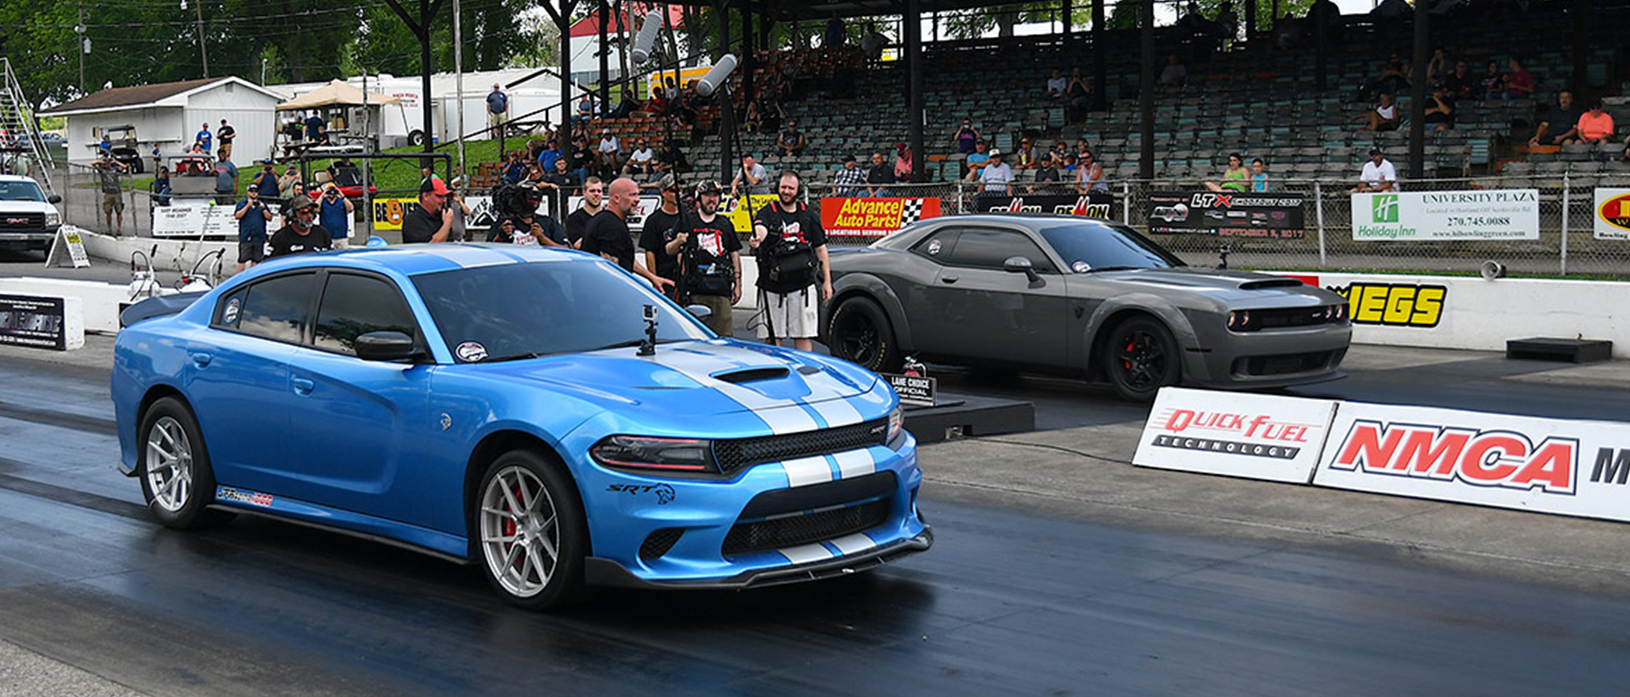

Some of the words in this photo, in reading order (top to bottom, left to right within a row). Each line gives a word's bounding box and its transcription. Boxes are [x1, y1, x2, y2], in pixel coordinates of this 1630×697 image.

[1190, 193, 1232, 208] LTX
[1423, 193, 1492, 203] UNIVERSITY
[1496, 192, 1535, 203] PLAZA
[841, 198, 899, 214] Advance
[834, 214, 864, 227] Auto
[864, 215, 896, 228] Parts
[1448, 216, 1510, 226] 270.745.0088
[1219, 228, 1268, 237] SEPTEMBER
[1281, 229, 1304, 238] 2017
[1358, 225, 1397, 238] Holiday
[1399, 225, 1416, 236] Inn
[893, 386, 927, 396] OFFICIAL
[1164, 409, 1247, 433] QUICK
[1159, 436, 1293, 457] TECHNOLOGY
[1332, 421, 1578, 494] NMCA
[605, 484, 657, 495] SRT
